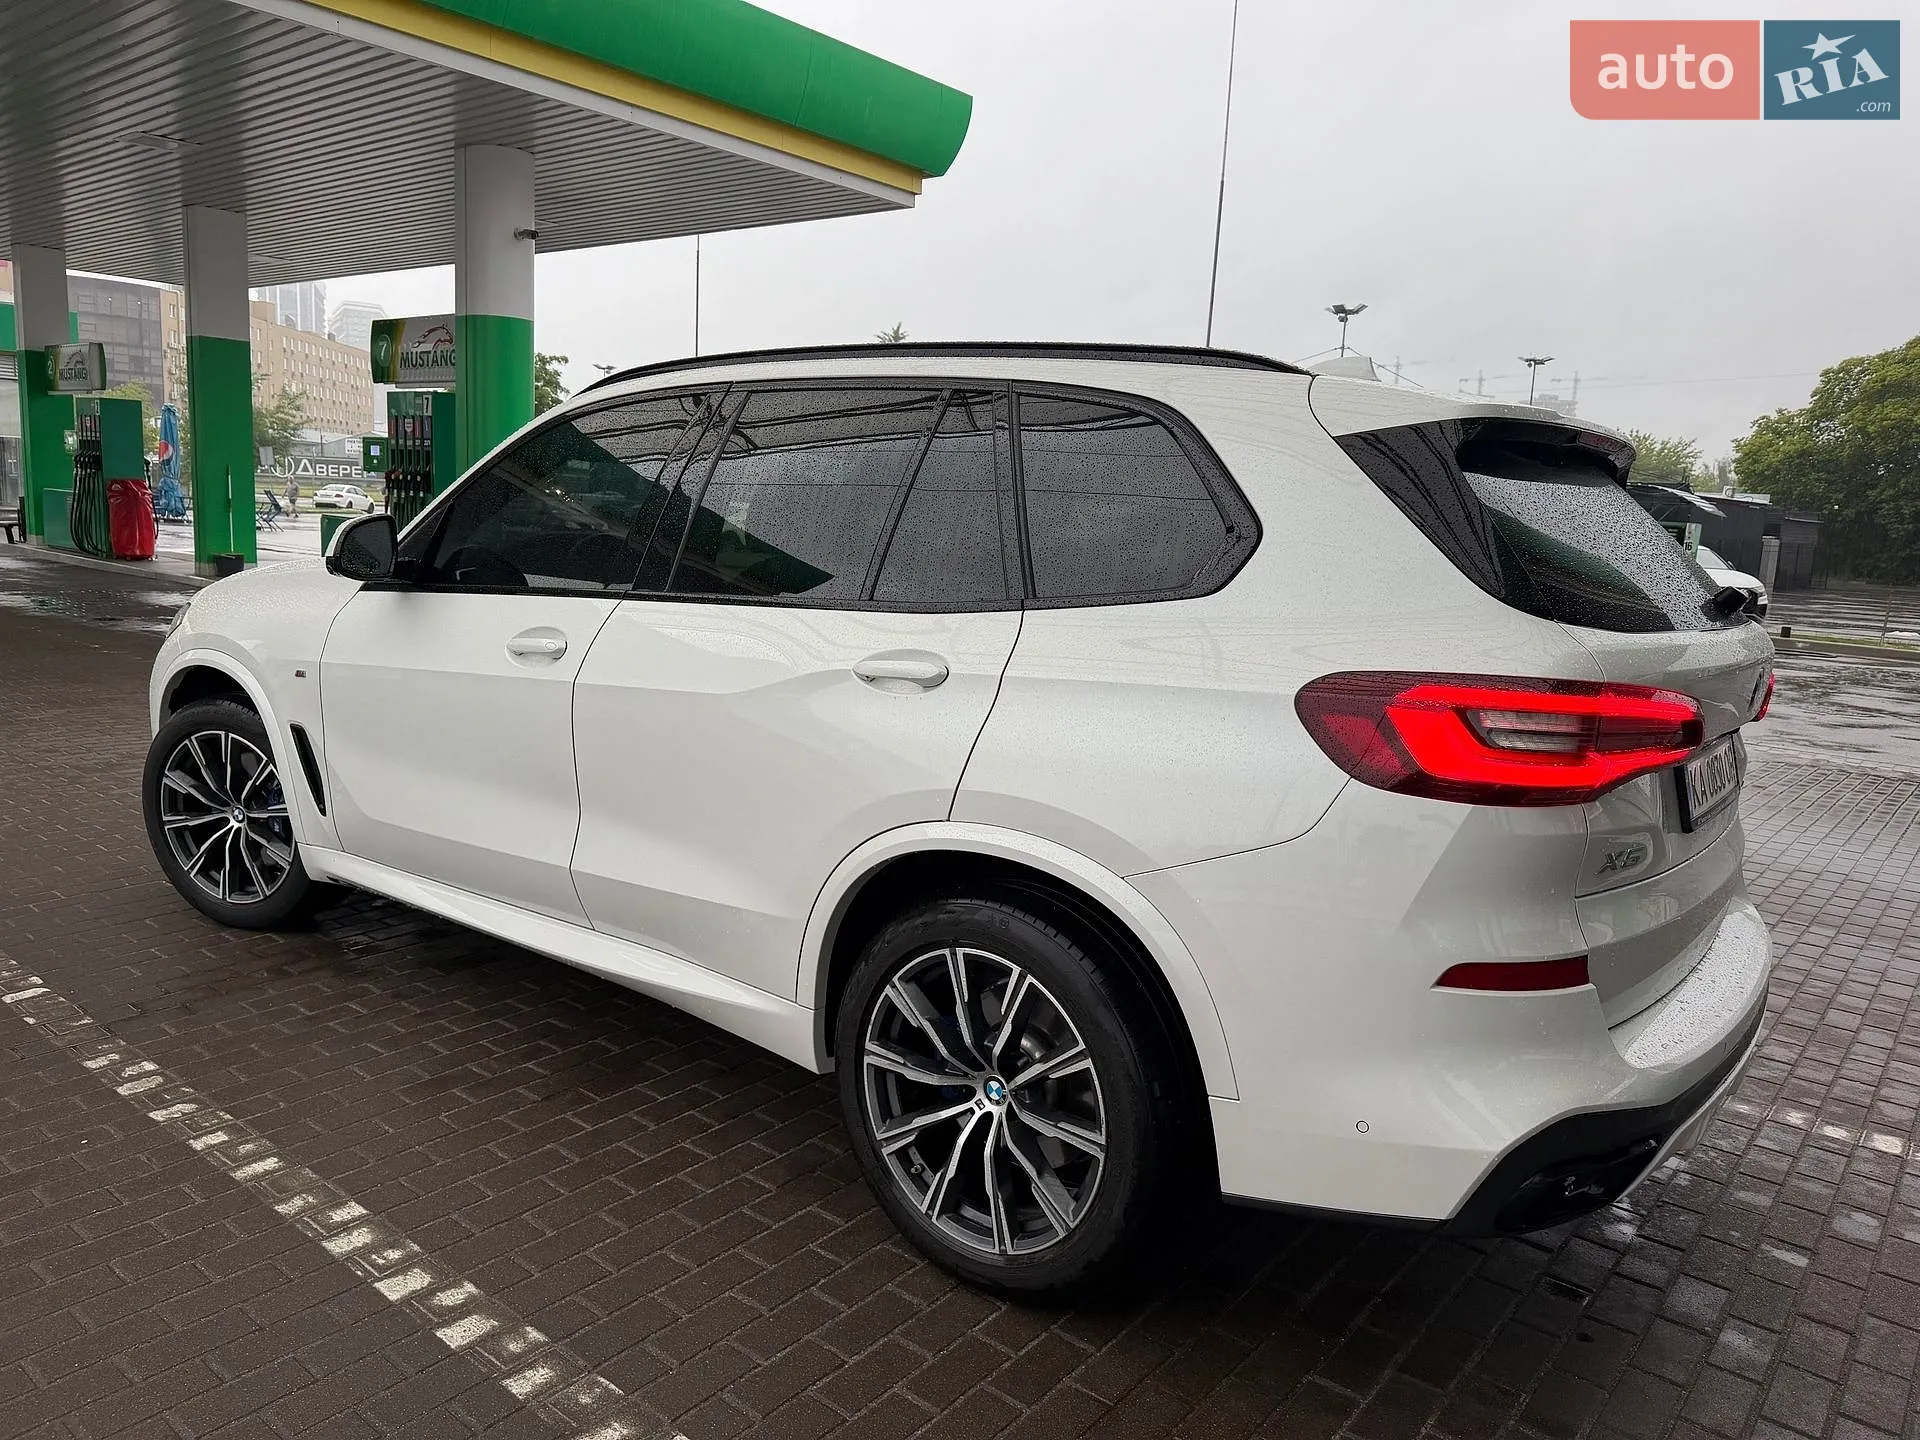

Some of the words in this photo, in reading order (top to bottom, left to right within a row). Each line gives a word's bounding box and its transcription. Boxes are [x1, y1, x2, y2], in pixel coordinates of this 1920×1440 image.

[59, 367, 88, 381] MUSTANG
[424, 396, 430, 414] 7
[1684, 541, 1693, 551] 16
[1689, 762, 1709, 810] KA
[1593, 846, 1648, 875] X5
